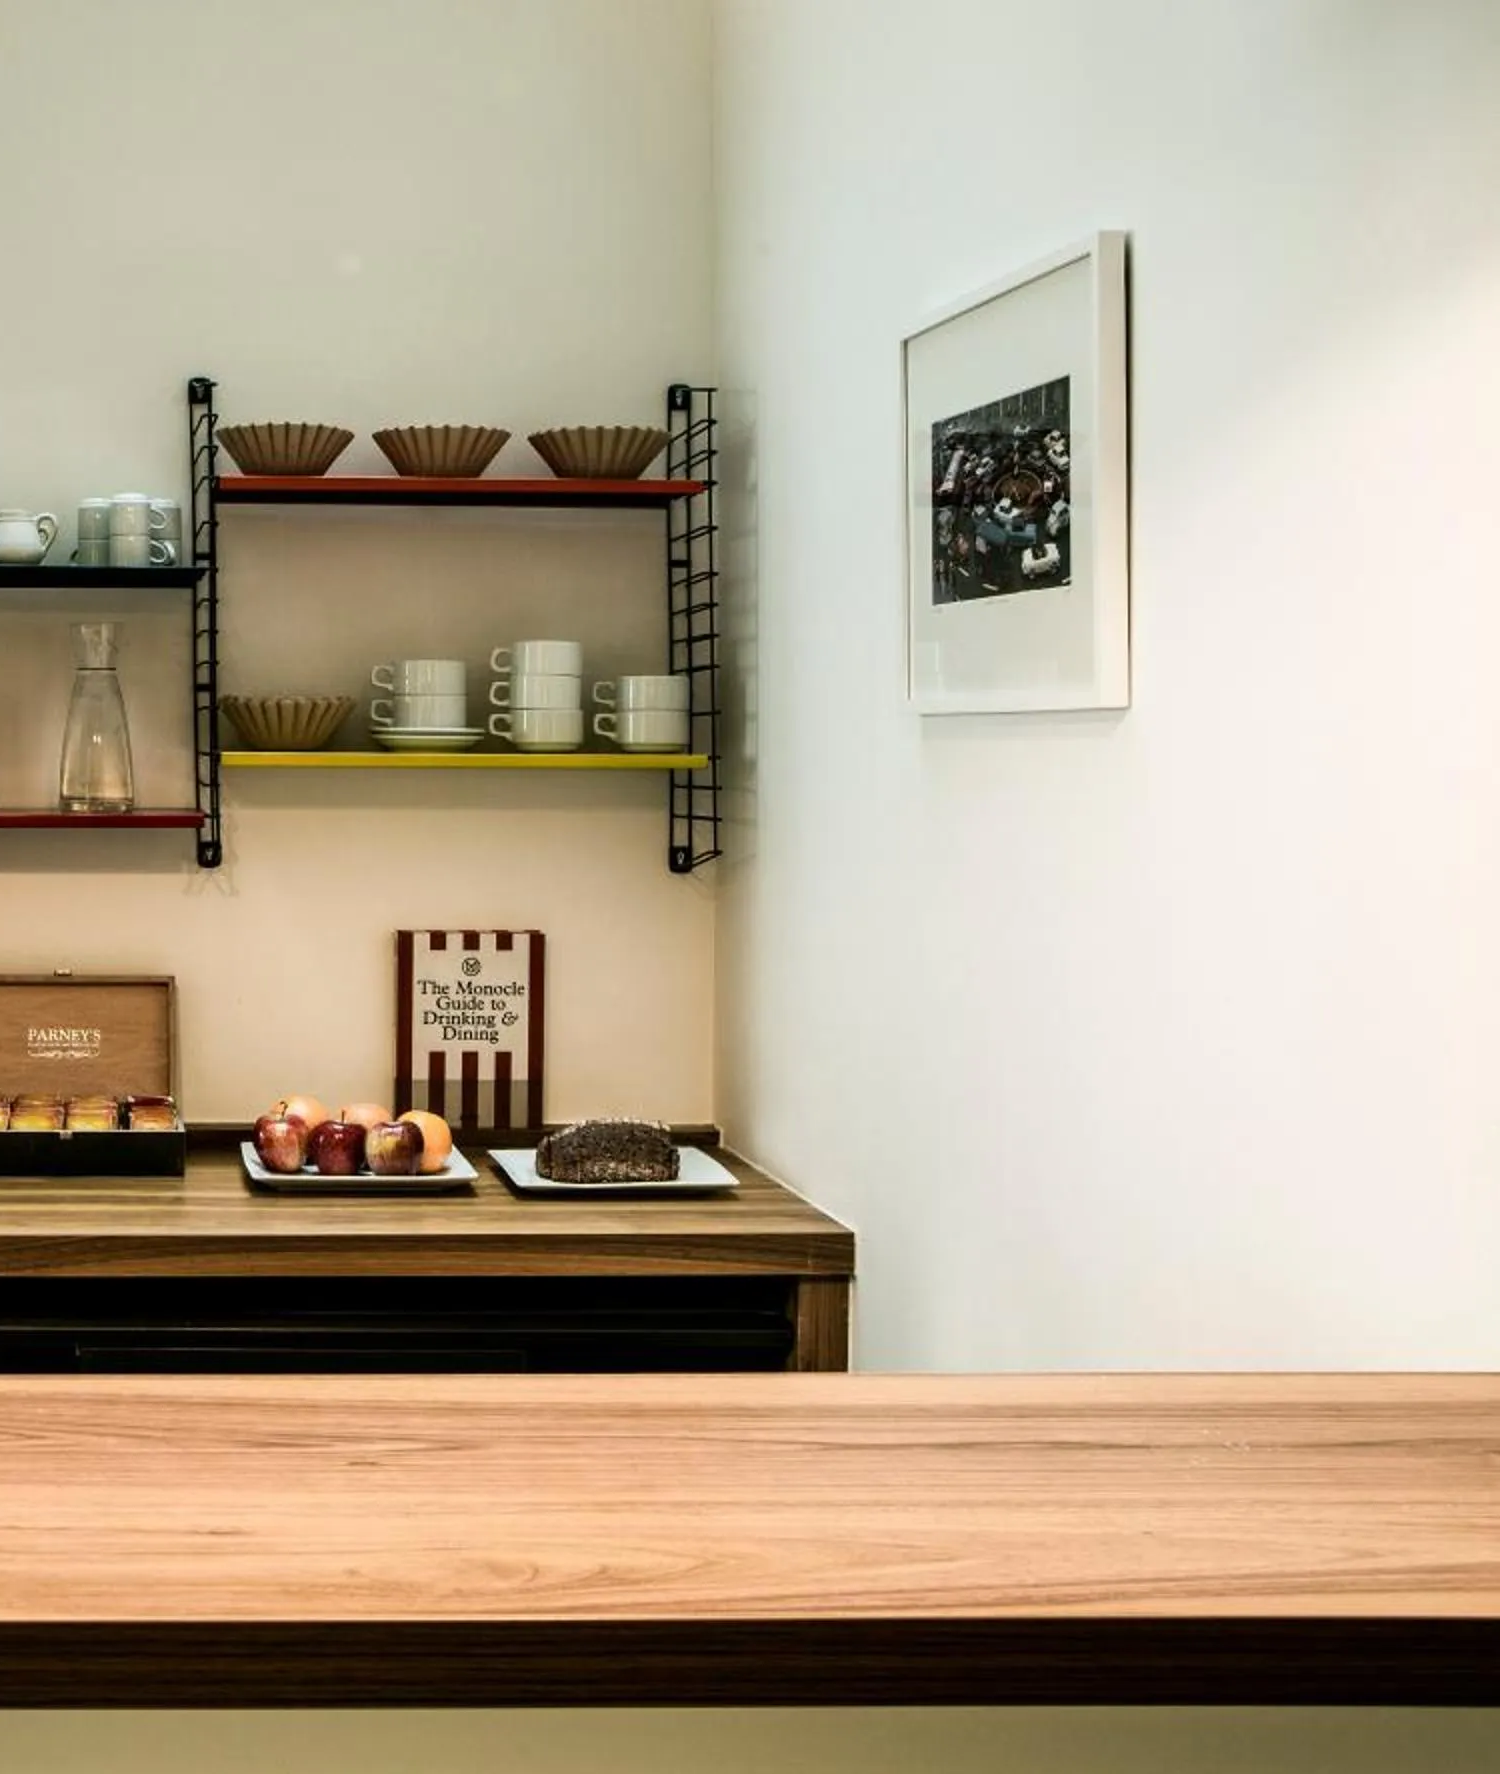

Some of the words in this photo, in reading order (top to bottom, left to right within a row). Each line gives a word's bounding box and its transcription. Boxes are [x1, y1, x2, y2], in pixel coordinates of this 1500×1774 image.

[417, 980, 450, 995] The
[455, 981, 525, 996] Monocle
[436, 996, 485, 1010] Guide
[491, 999, 507, 1010] to
[423, 1011, 497, 1028] Drinking
[501, 1011, 520, 1026] &
[442, 1026, 499, 1044] Dining
